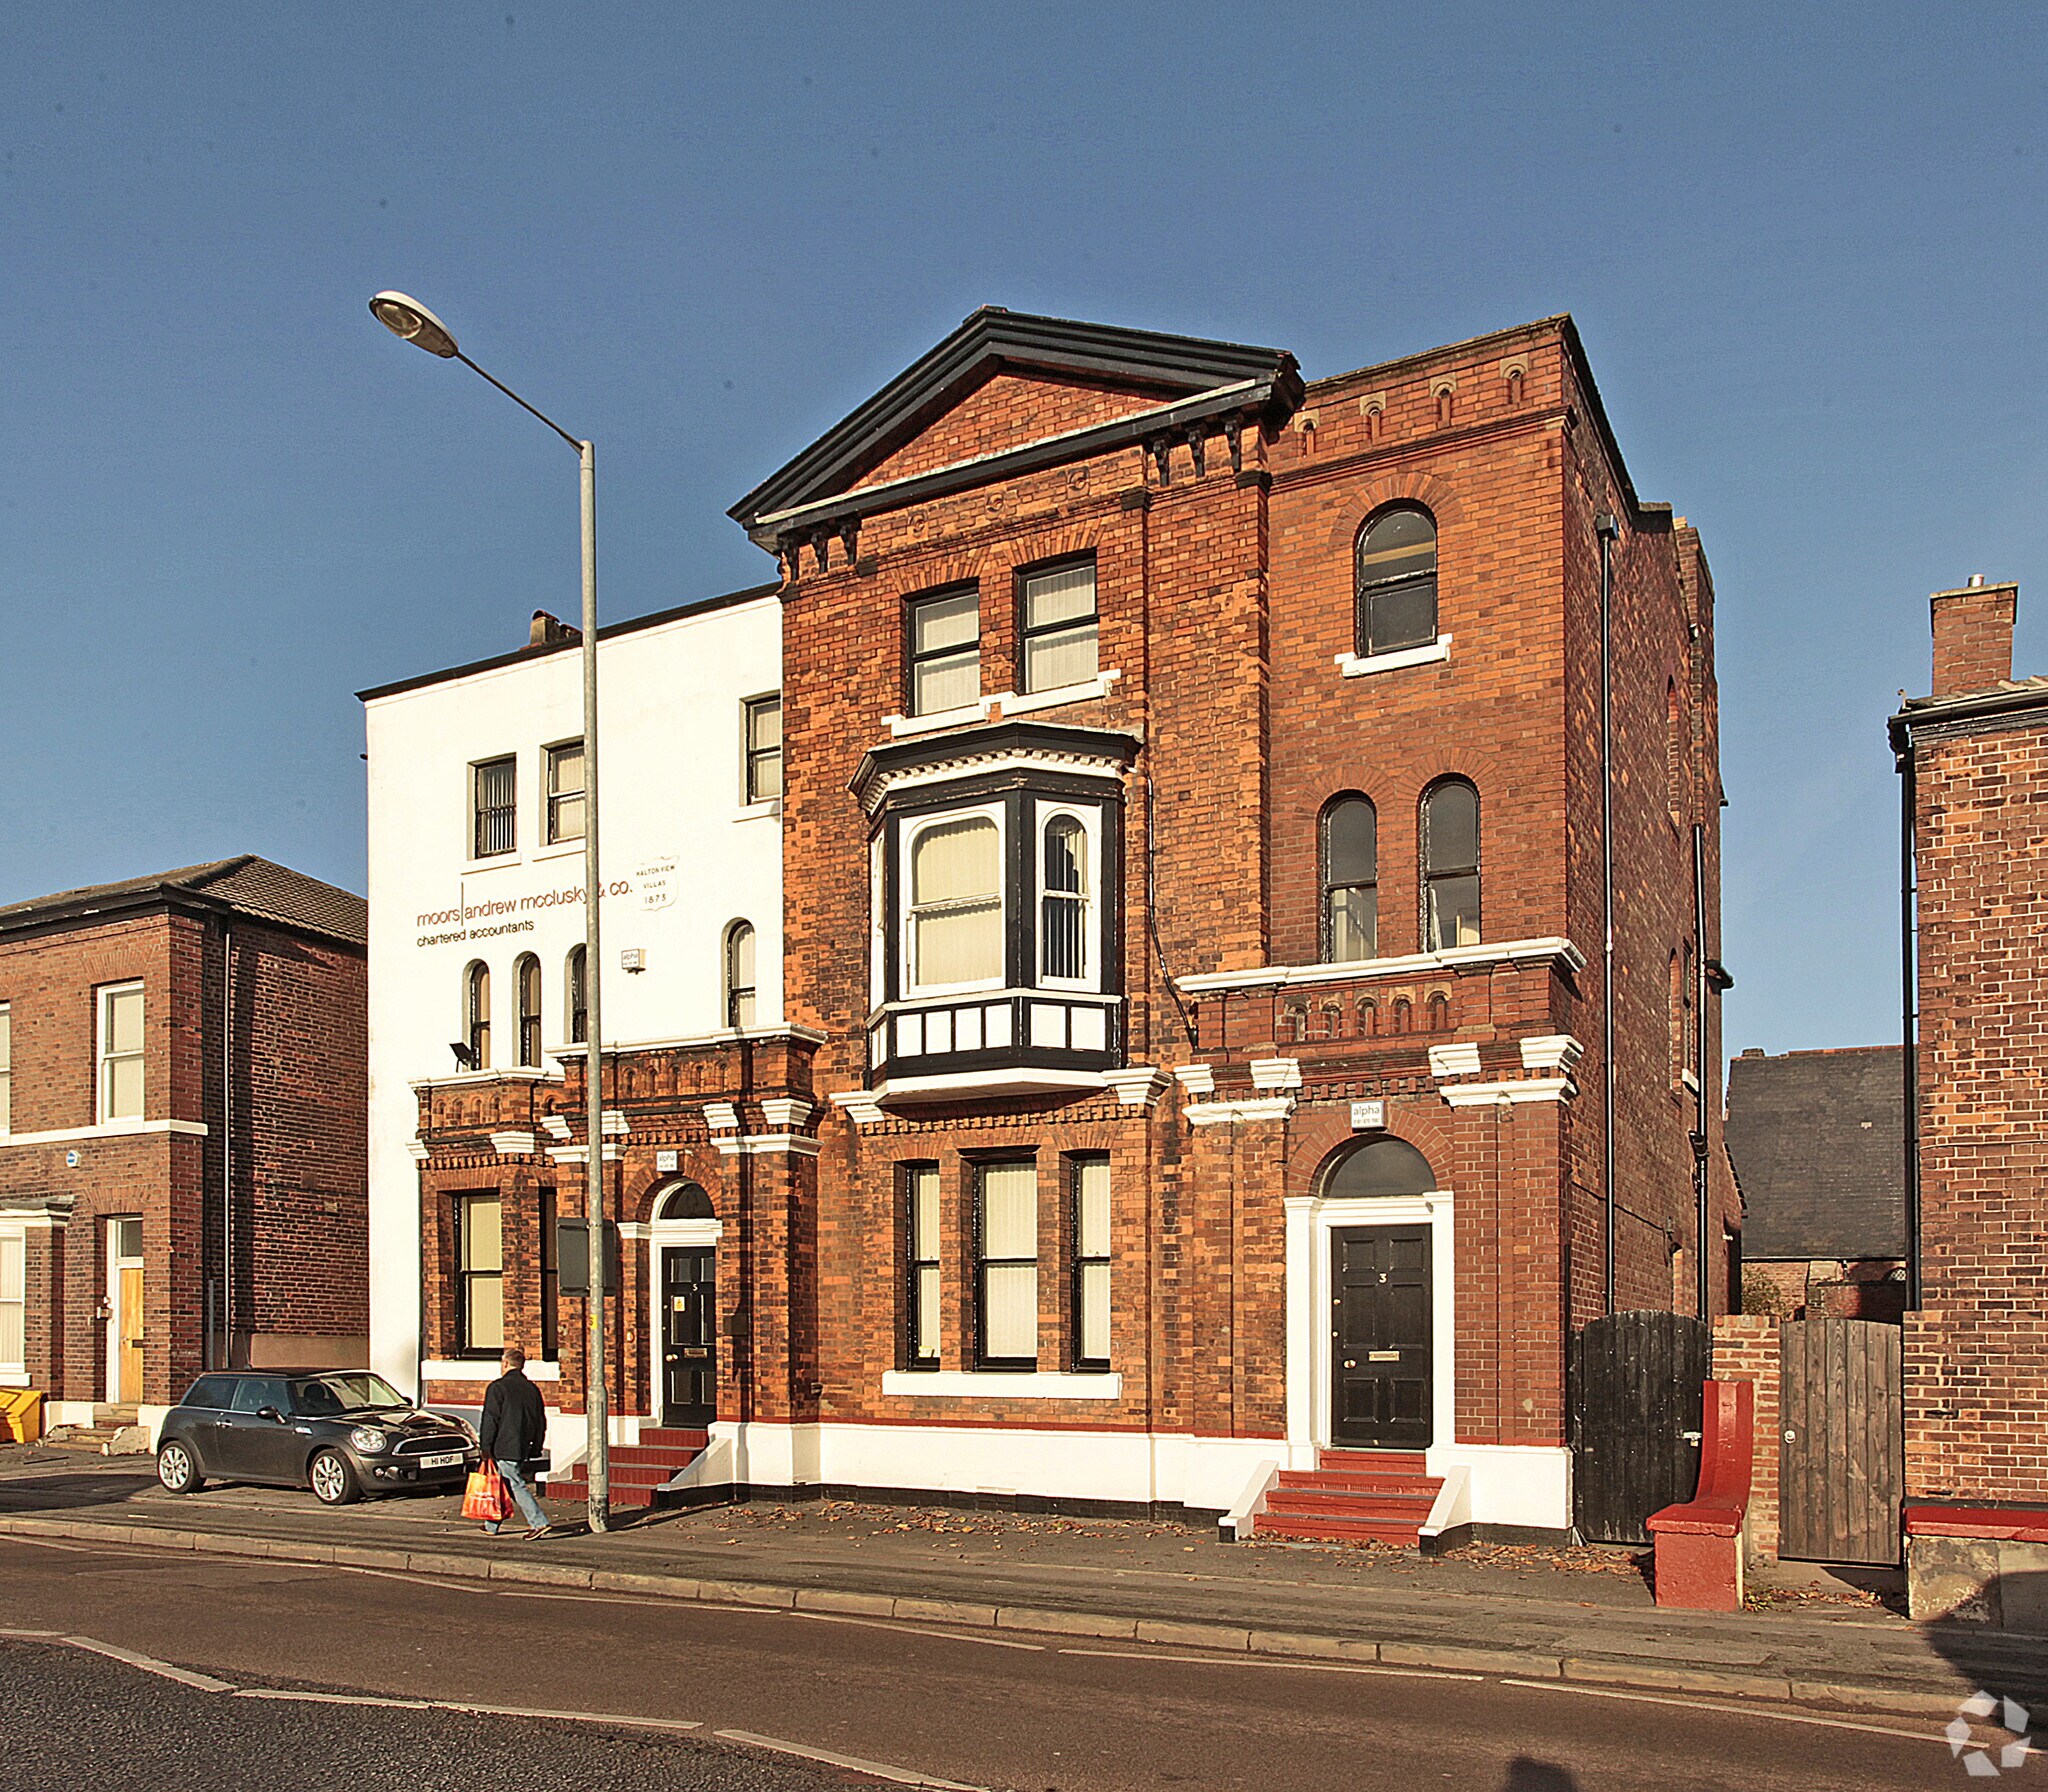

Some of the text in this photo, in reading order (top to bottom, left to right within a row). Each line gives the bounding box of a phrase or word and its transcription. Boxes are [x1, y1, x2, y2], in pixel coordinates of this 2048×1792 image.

[609, 880, 633, 896] co.
[643, 879, 666, 889] VILLAS
[417, 919, 534, 947] chartered accountants
[1353, 1105, 1380, 1117] alpha
[658, 1154, 675, 1162] alpha
[1378, 1273, 1387, 1283] 3
[440, 1455, 454, 1464] HOF
